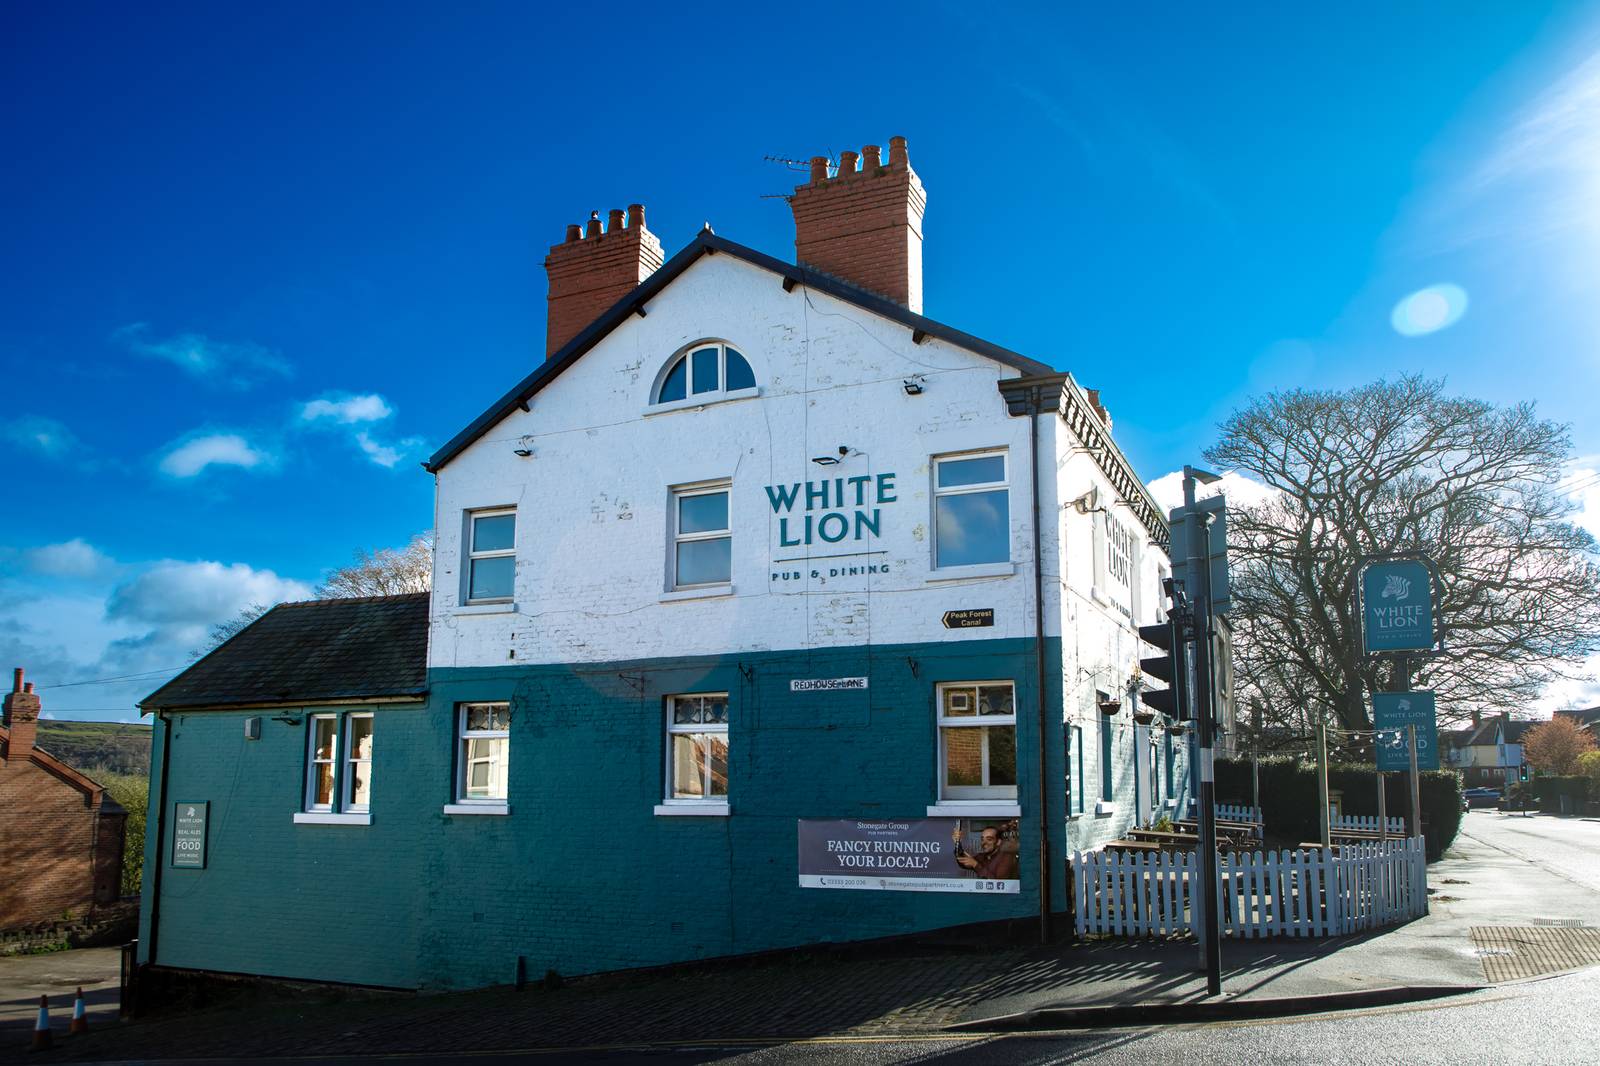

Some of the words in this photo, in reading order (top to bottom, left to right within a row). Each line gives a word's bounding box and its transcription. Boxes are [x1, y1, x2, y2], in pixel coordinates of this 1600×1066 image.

[764, 472, 897, 514] WHITE
[780, 508, 880, 547] LION
[771, 571, 801, 581] PUB
[810, 569, 820, 578] &
[829, 564, 889, 577] DINING
[950, 611, 968, 619] Peak
[969, 610, 992, 618] Forest
[1373, 604, 1424, 617] WHITE
[1380, 616, 1418, 628] LION
[794, 680, 838, 689] REDHOUSE
[841, 679, 865, 688] LANE
[857, 822, 888, 830] Stonegate
[888, 822, 909, 830] Group
[177, 841, 201, 850] FOOD
[827, 840, 872, 852] FANCY
[874, 841, 941, 853] RUNNING
[837, 855, 875, 867] YOUR
[878, 856, 930, 869] LOCAL?
